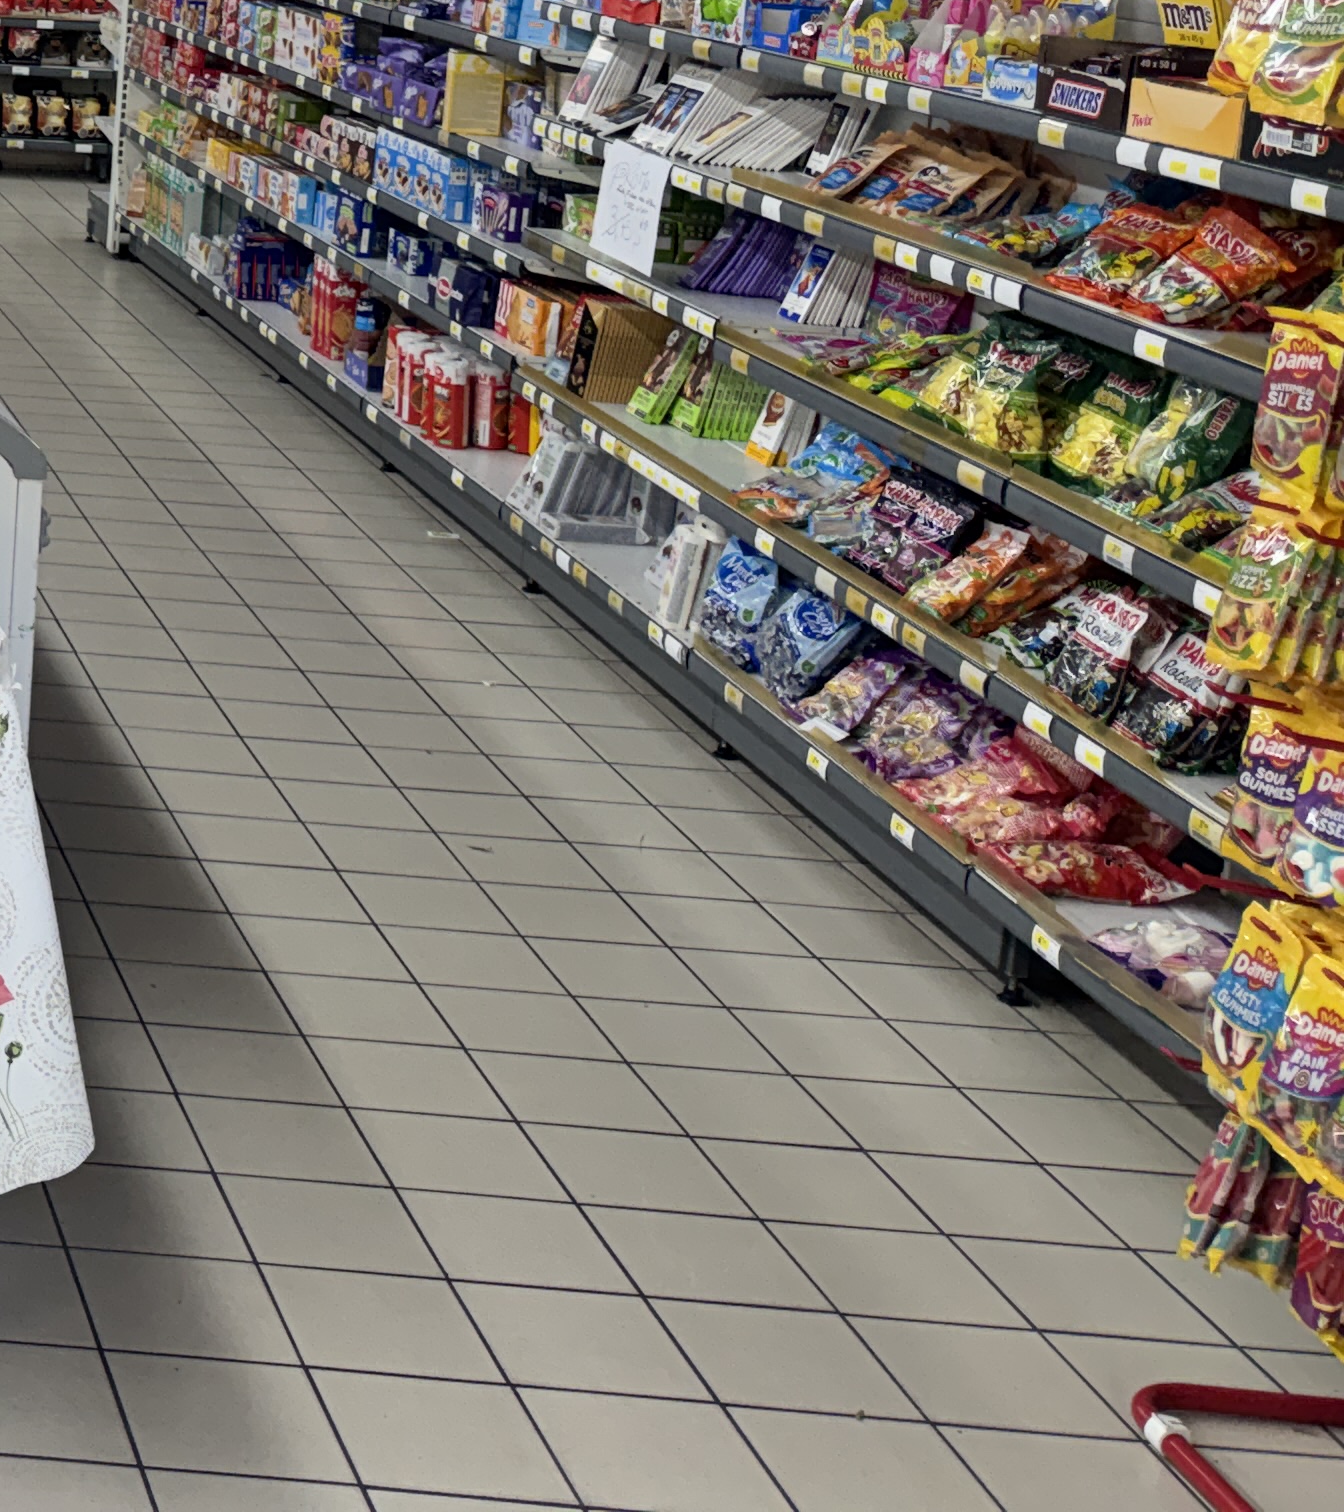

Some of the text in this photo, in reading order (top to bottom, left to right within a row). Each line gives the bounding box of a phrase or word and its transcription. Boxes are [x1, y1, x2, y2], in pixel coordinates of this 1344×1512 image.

[1050, 79, 1103, 115] SNICKERS
[1131, 112, 1154, 128] Twix
[1273, 351, 1324, 372] Damel
[1177, 638, 1223, 677] HARIB
[1249, 735, 1306, 761] Damel
[1241, 775, 1296, 803] GUMMIES
[1255, 767, 1287, 787] SOUR
[1233, 952, 1278, 987] Damel
[1216, 993, 1262, 1029] GUMMIES
[1233, 984, 1265, 1012] TASTY
[1294, 1011, 1344, 1049] Dame
[1291, 1047, 1328, 1072] RAIN
[1277, 1061, 1330, 1094] WOW
